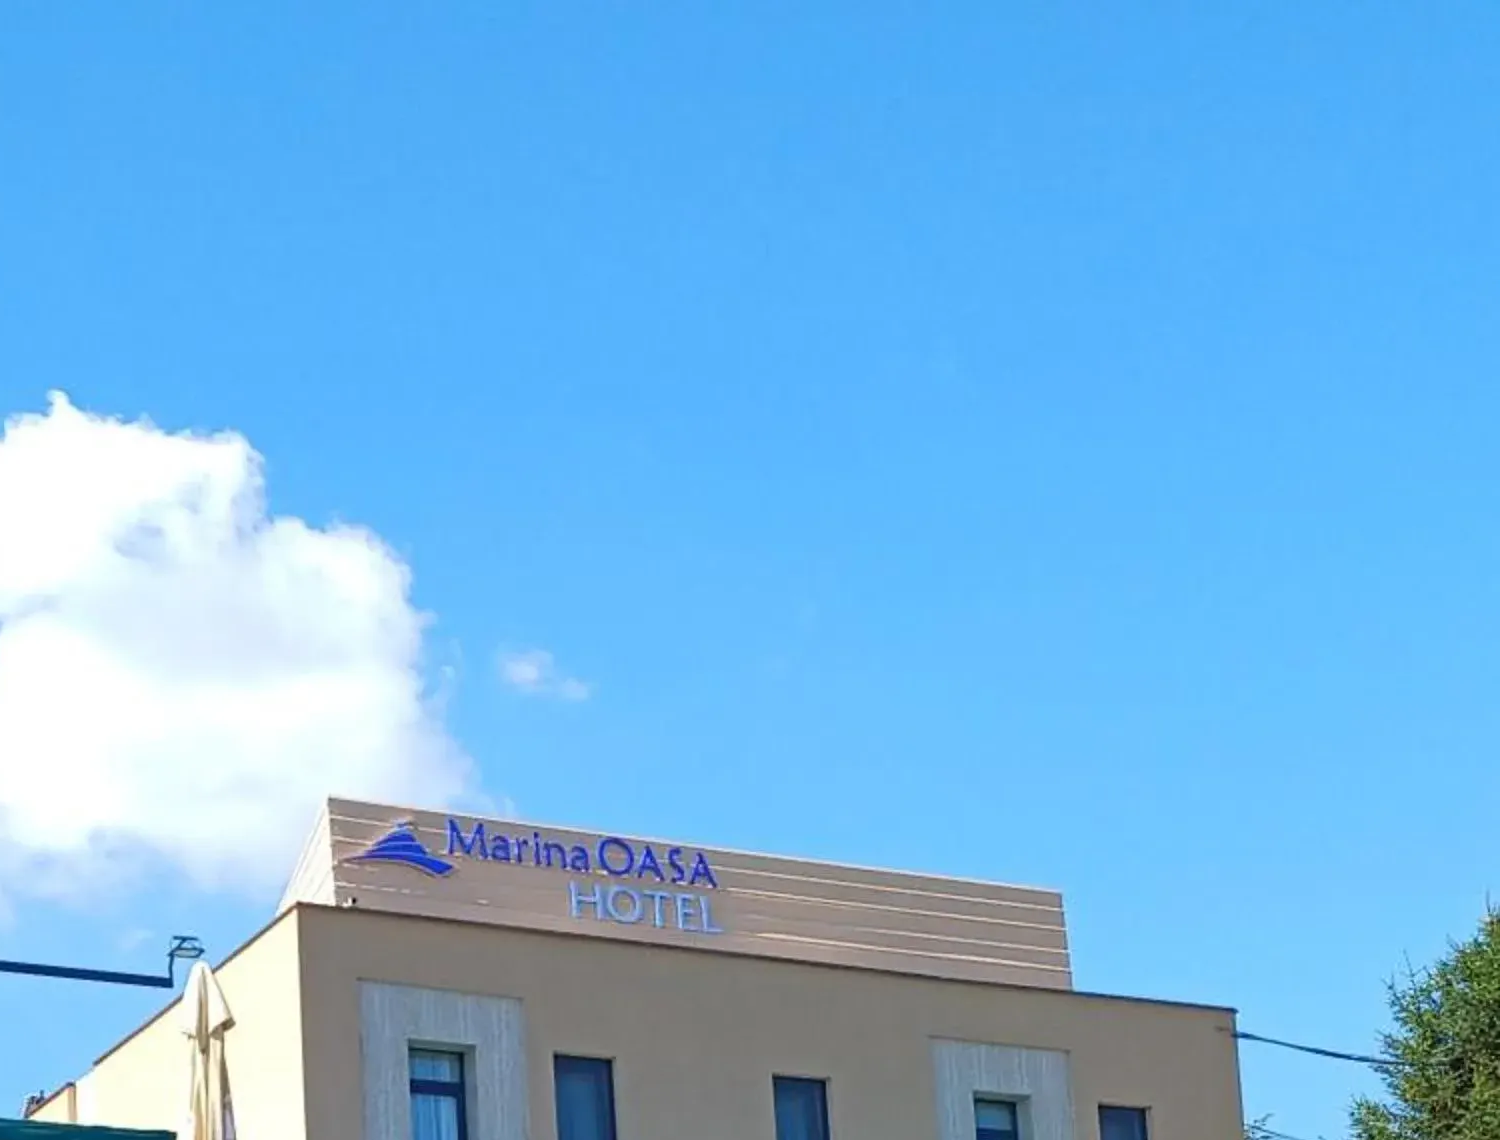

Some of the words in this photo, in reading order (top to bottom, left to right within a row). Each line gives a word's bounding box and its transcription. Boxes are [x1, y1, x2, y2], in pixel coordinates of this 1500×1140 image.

[448, 819, 591, 872] Marina
[598, 836, 718, 888] OASA
[569, 881, 723, 934] HOTEL
